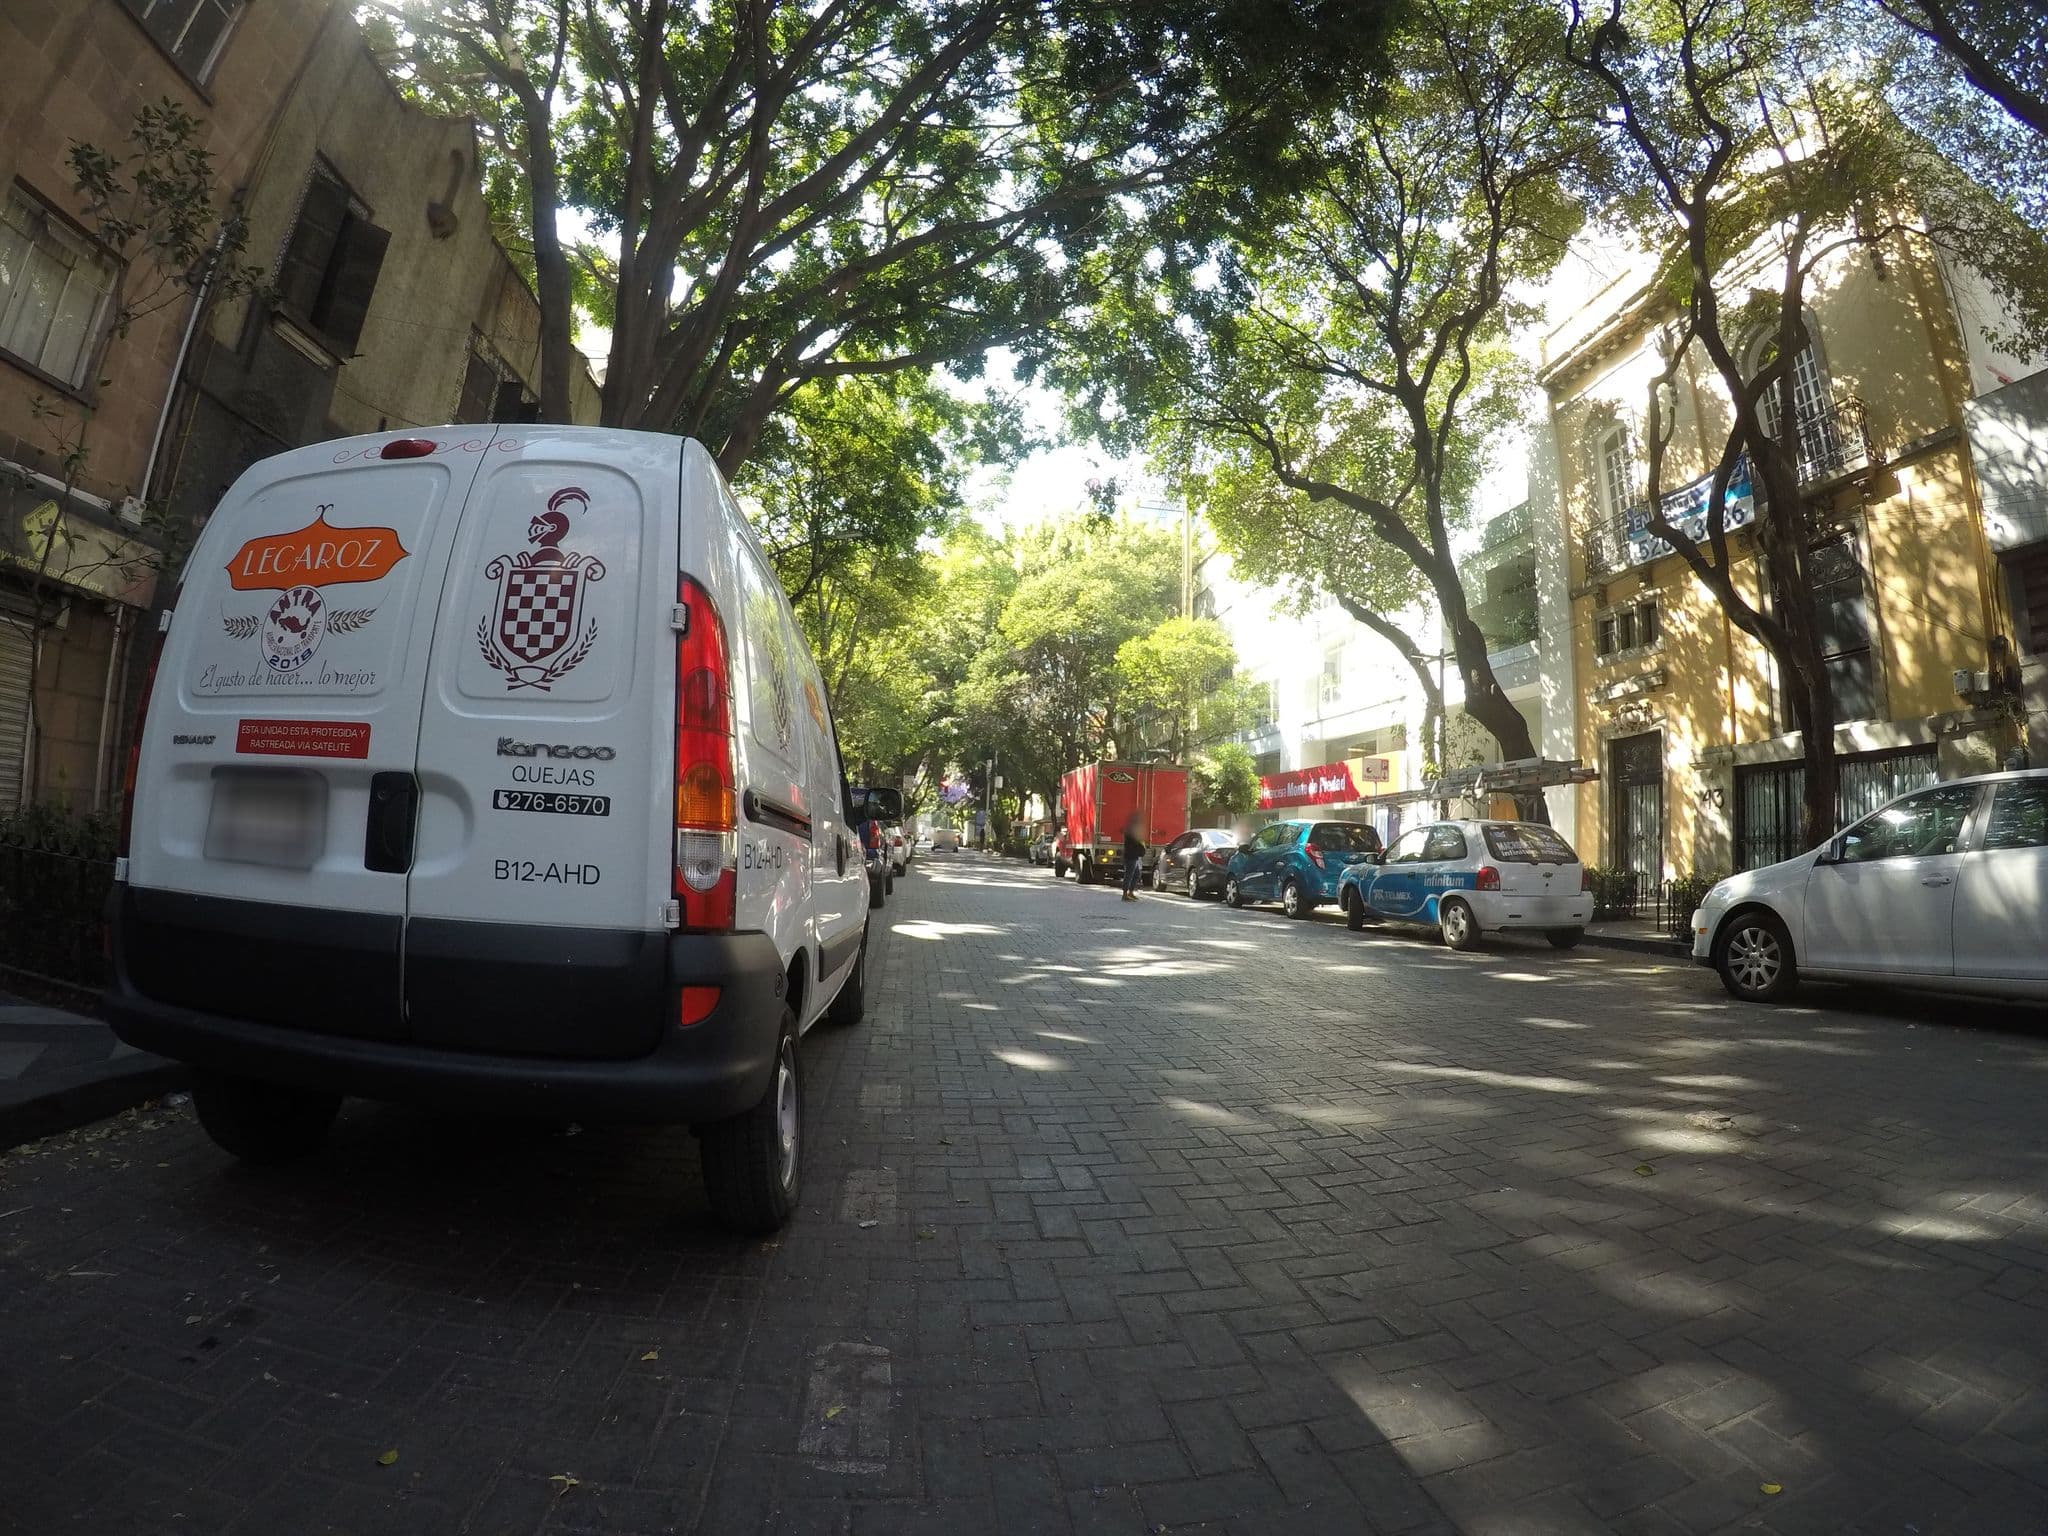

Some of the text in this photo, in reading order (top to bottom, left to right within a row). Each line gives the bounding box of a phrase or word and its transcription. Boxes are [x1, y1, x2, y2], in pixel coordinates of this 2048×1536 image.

[242, 539, 383, 577] LECAROZ
[269, 648, 313, 669] 2018
[200, 663, 216, 688] El
[215, 669, 245, 693] gusto
[248, 661, 263, 686] de
[318, 659, 332, 685] lo
[334, 669, 377, 691] mejor
[241, 725, 367, 739] ESTA UNIDAD ESTA PROTEGIDA Y
[250, 739, 351, 752] RASTREADA VIA SATELITE
[512, 765, 595, 787] QUEJAS
[1287, 782, 1307, 797] Monte
[1308, 778, 1318, 794] de
[1320, 773, 1346, 792] Piedad
[497, 790, 606, 815] 5276-6570
[744, 843, 782, 870] B12-AHD
[494, 859, 601, 886] B12-AHD
[1423, 873, 1465, 887] infinitum
